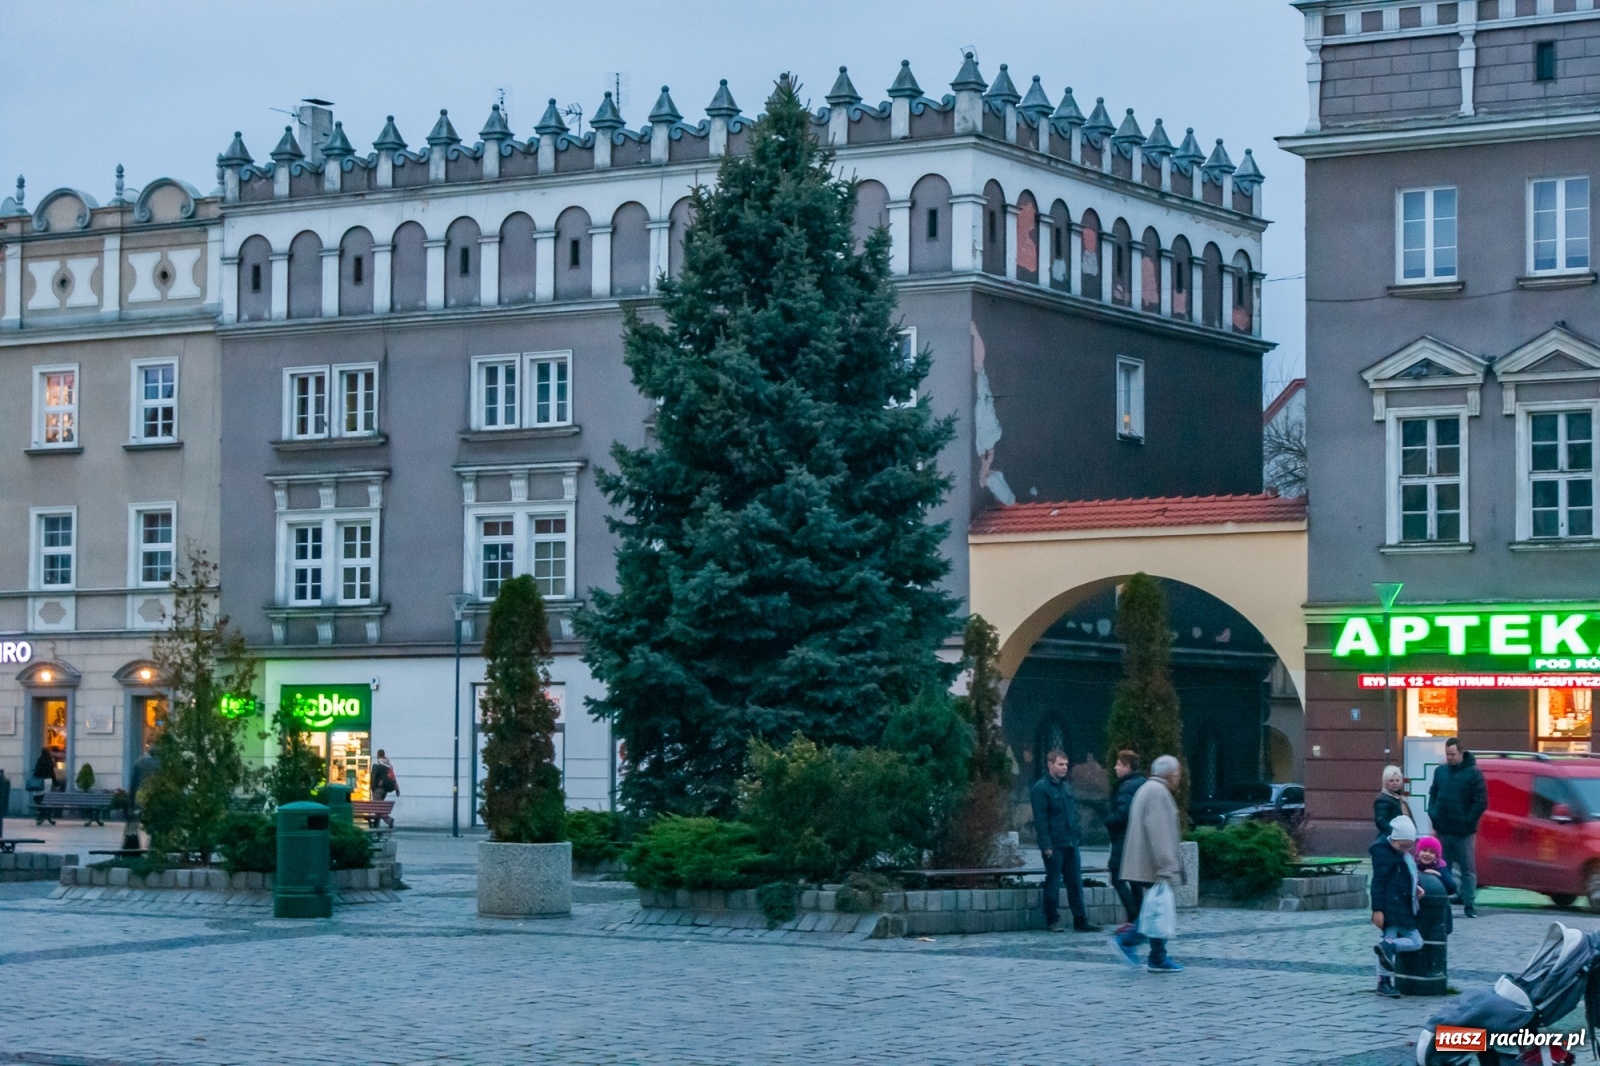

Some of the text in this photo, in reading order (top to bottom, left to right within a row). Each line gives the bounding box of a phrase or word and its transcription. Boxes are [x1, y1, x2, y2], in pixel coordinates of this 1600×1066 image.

[1333, 613, 1600, 656] APTEK
[1535, 658, 1572, 669] POD
[1408, 676, 1424, 687] 12
[1432, 676, 1495, 687] CENTRUM
